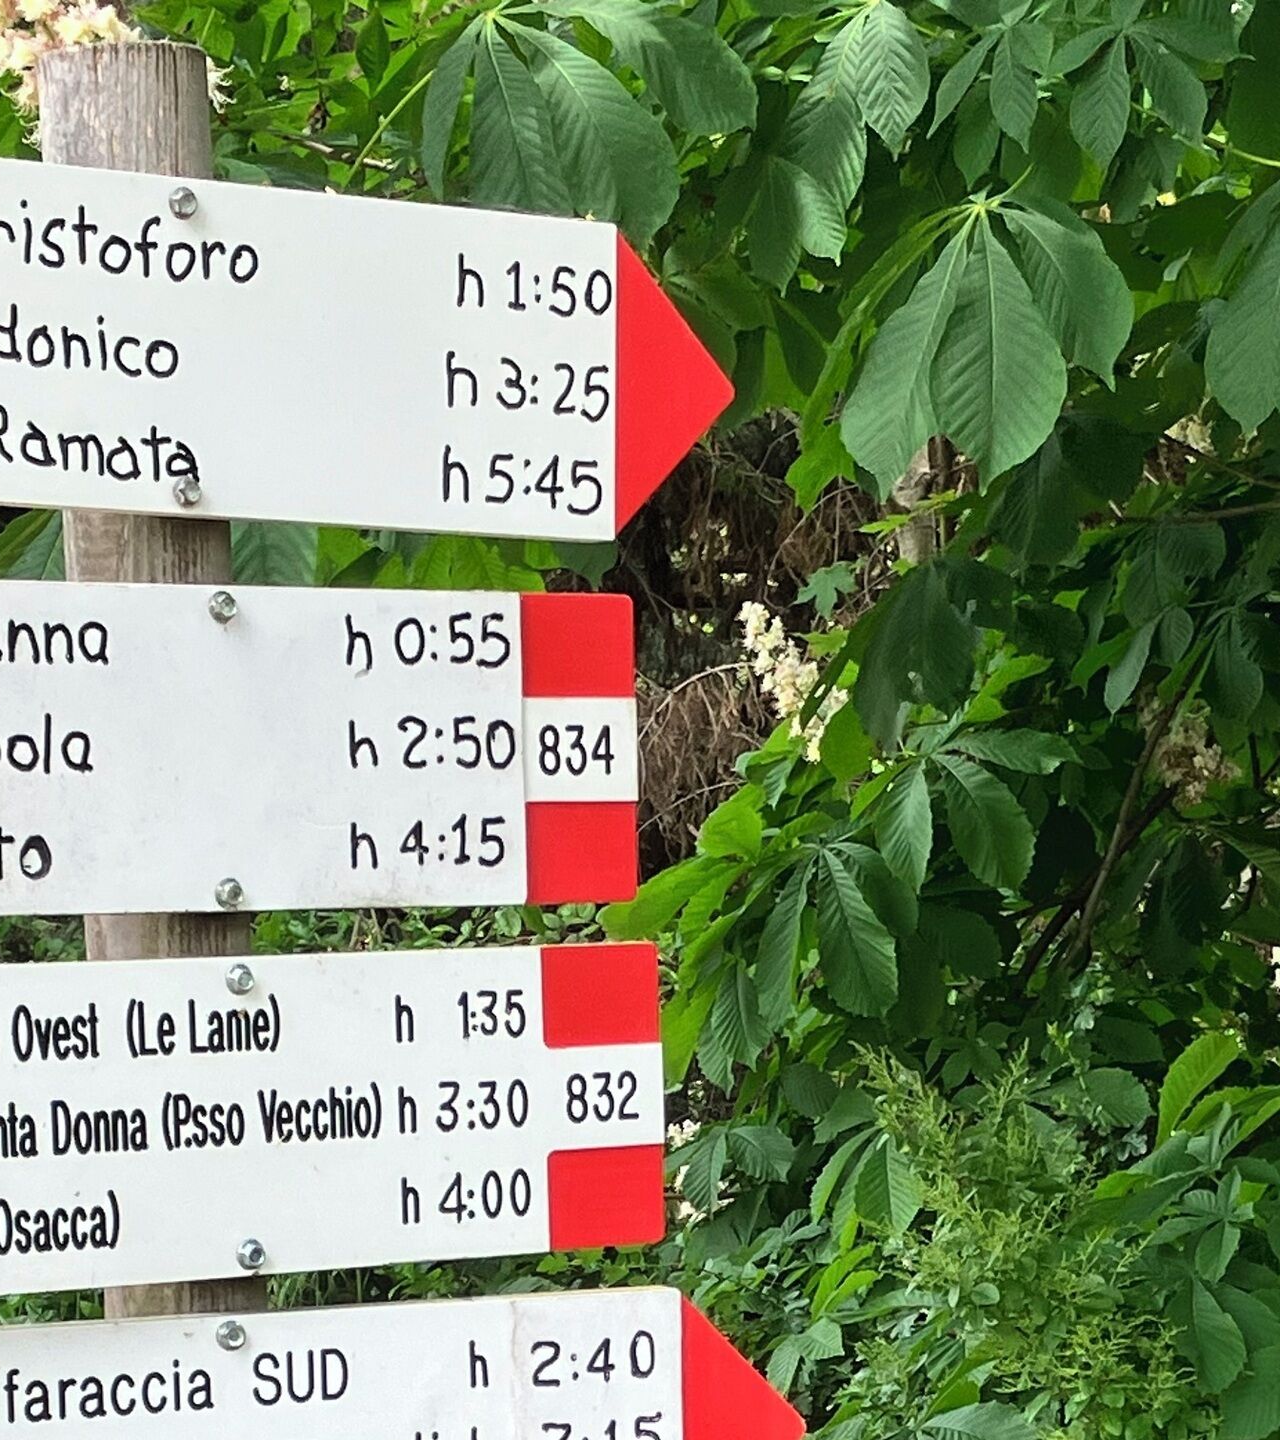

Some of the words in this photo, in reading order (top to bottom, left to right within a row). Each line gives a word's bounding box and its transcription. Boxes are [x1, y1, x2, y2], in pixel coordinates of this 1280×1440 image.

[456, 252, 484, 308] h
[506, 260, 612, 317] 1:50
[446, 350, 478, 408] h
[496, 357, 610, 423] 3:25
[442, 444, 470, 504] h
[485, 453, 602, 516] 5:45
[345, 613, 373, 671] h
[394, 611, 511, 669] 0:55
[348, 719, 379, 769] h
[397, 715, 516, 770] 2:50
[539, 724, 615, 776] 834
[350, 822, 378, 870] h
[399, 813, 506, 867] 4:15
[11, 1002, 100, 1063] Ovest
[126, 998, 176, 1059] (Le
[188, 993, 281, 1054] Lame)
[395, 994, 414, 1043] h
[457, 989, 526, 1039] 1:35
[50, 1099, 148, 1156] Donna
[162, 1091, 245, 1151] (P.sso
[257, 1081, 382, 1144] Vecchio)
[398, 1086, 417, 1134] h
[436, 1078, 529, 1133] 3:30
[566, 1070, 640, 1124] 832
[401, 1177, 420, 1225] h
[439, 1168, 531, 1224] 4:00
[253, 1348, 348, 1406] SUD
[469, 1340, 489, 1388] h
[530, 1330, 655, 1387] 2:40
